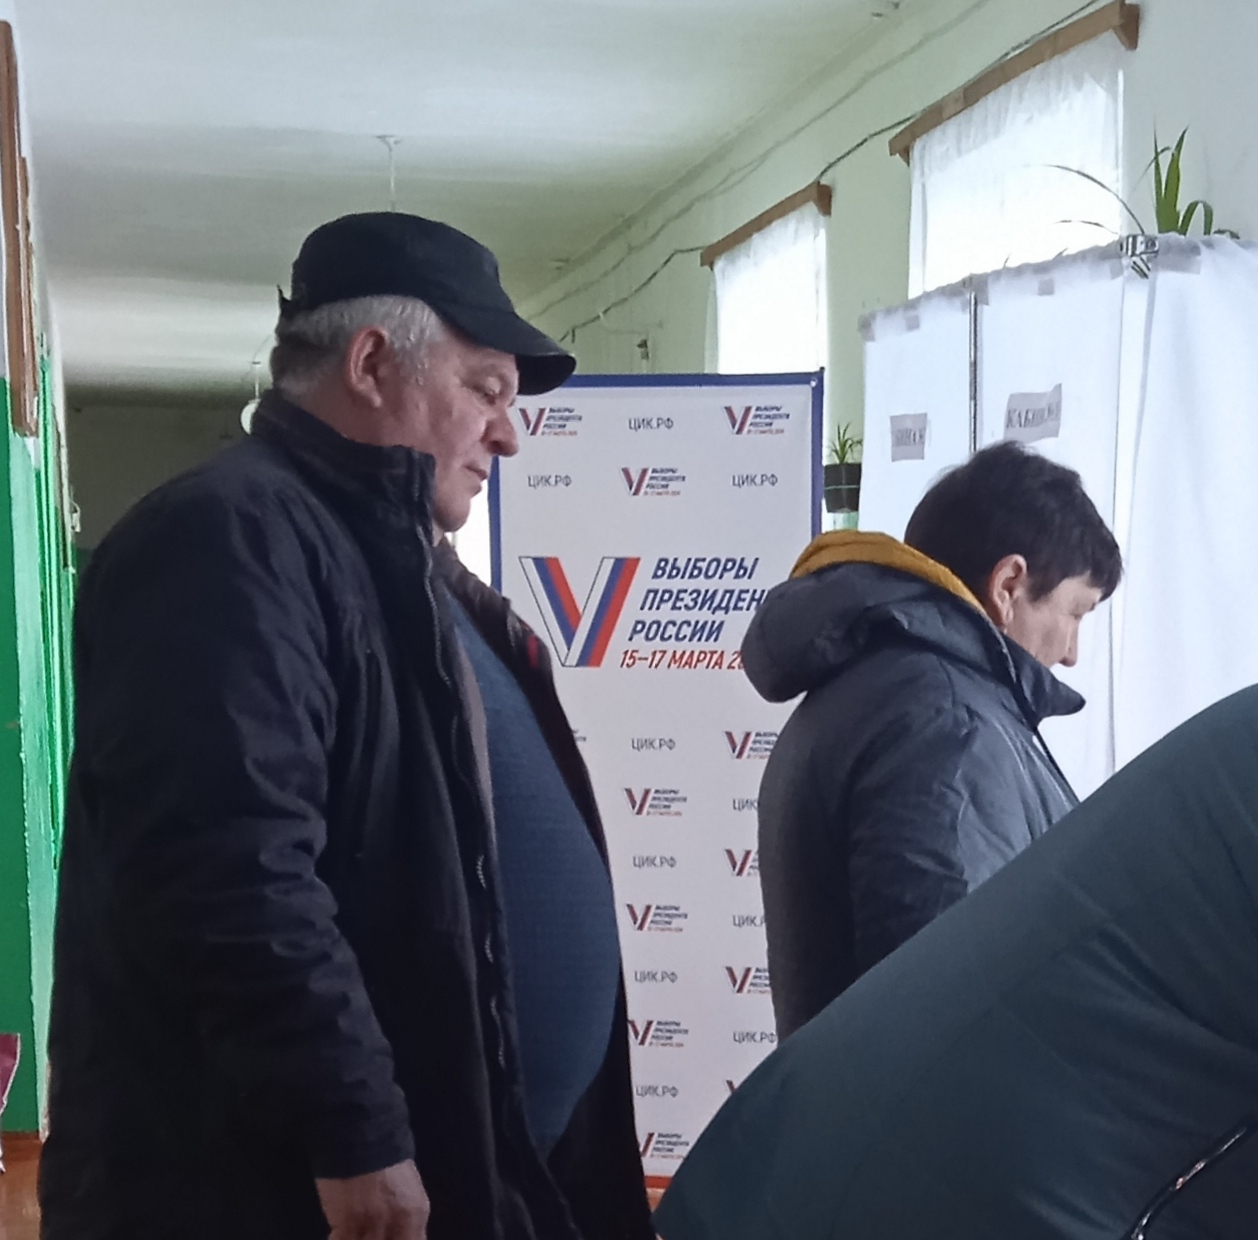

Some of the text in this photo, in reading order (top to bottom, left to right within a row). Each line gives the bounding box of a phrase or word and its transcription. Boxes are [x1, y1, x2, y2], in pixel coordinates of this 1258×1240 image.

[628, 417, 674, 432] ЦИК.РФ
[527, 475, 572, 489] ЦИК.РФ
[732, 474, 778, 488] ЦИК.РФ
[651, 557, 759, 581] ВЫБОРЫ
[639, 588, 769, 616] ПРЕЗИДЕН
[628, 620, 724, 643] РОССИИ
[667, 651, 724, 669] МАРТА
[631, 738, 676, 752] ЦИК.РФ
[632, 856, 677, 868] ЦИК.РФ
[634, 971, 678, 983] ЦИК.РФ
[732, 1031, 777, 1044] ЦИК.РФ
[635, 1086, 679, 1098] ЦИК.РФ
